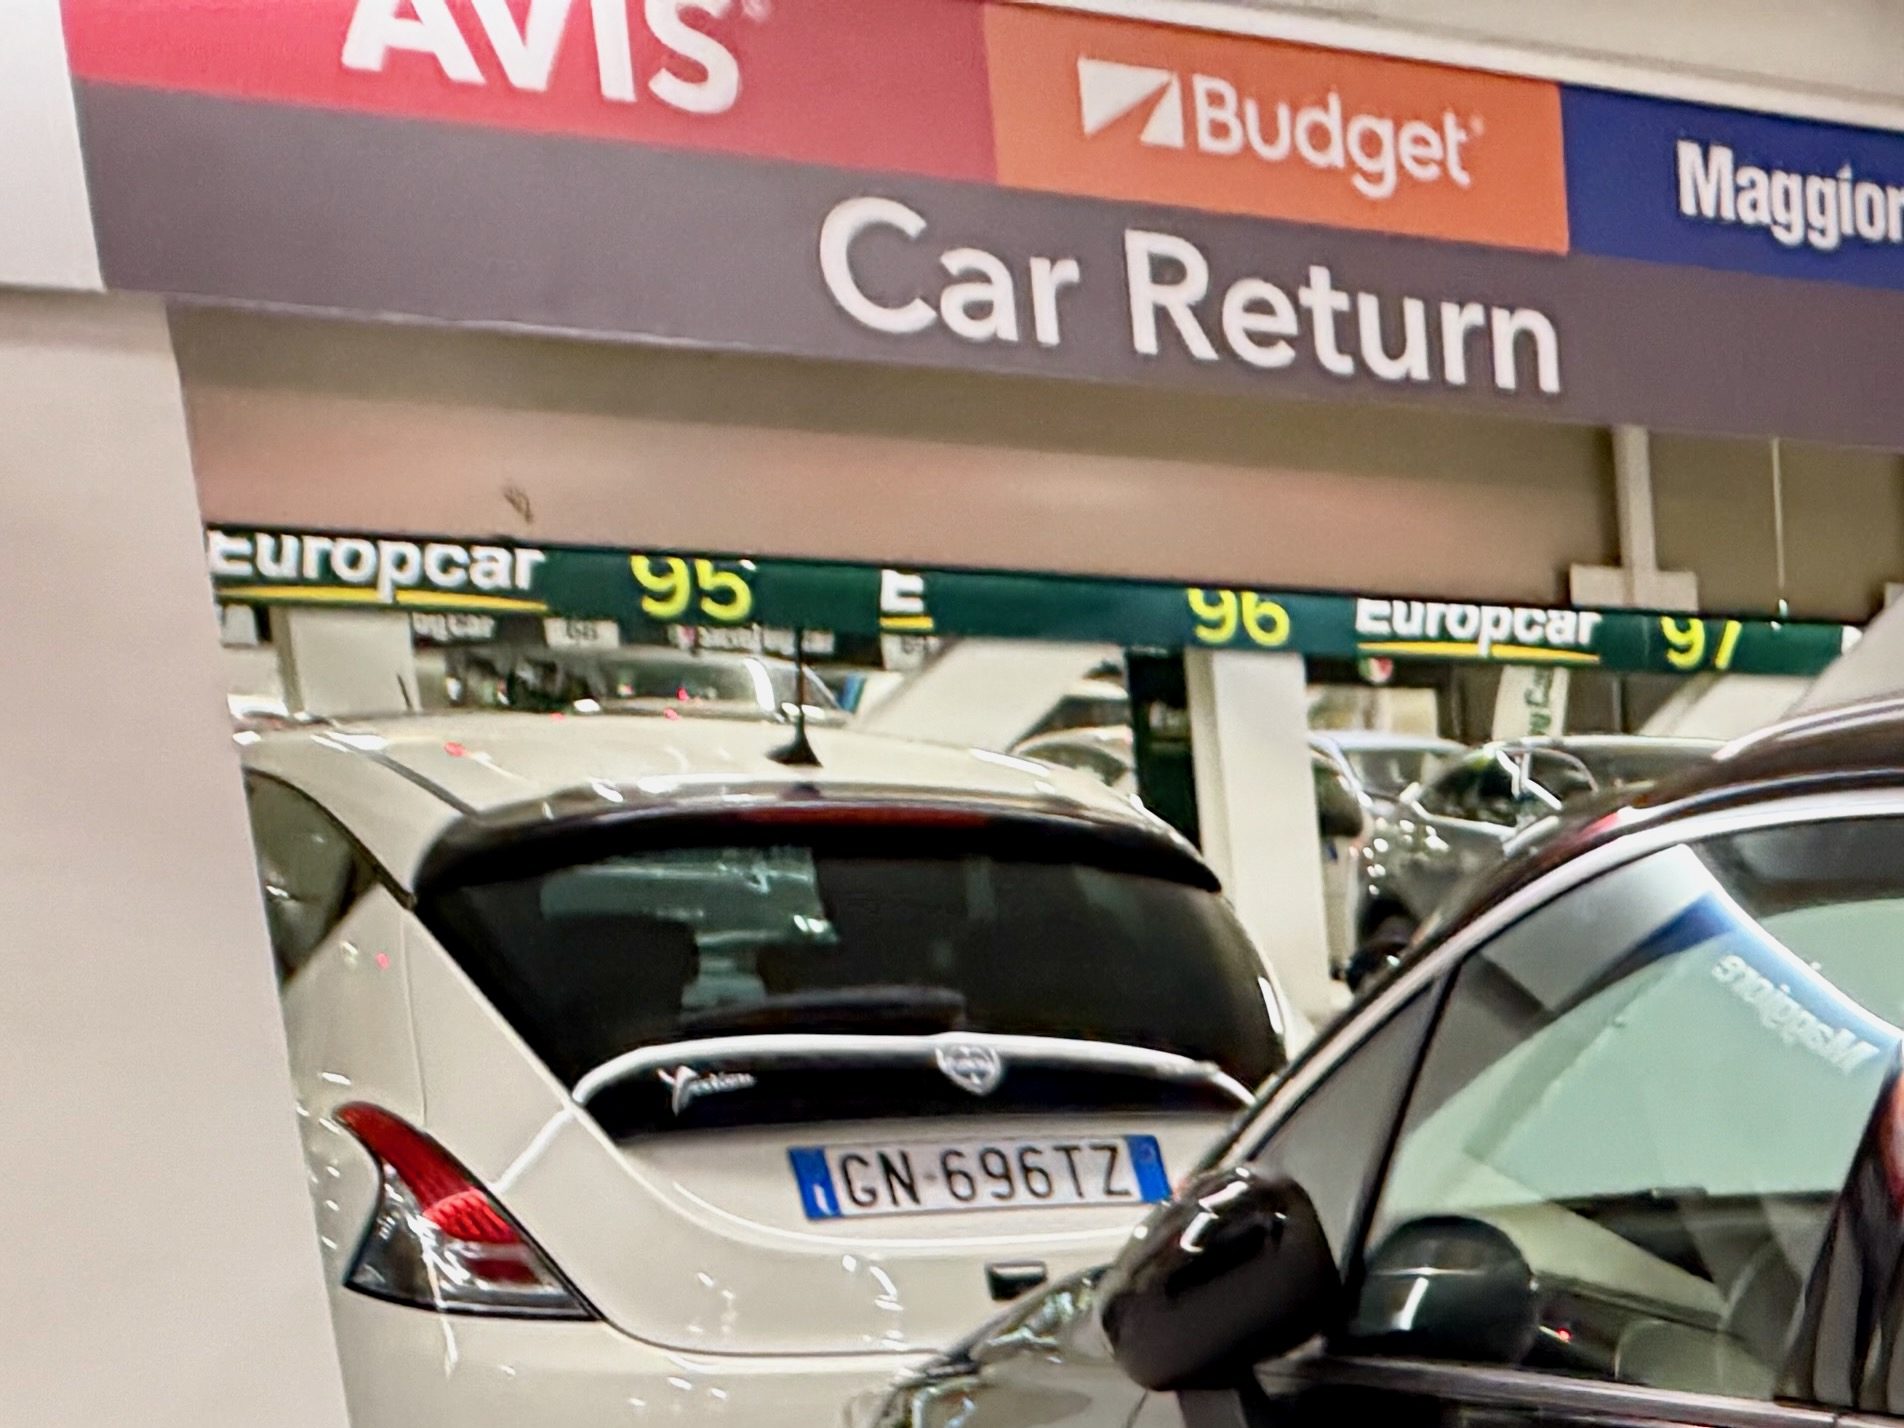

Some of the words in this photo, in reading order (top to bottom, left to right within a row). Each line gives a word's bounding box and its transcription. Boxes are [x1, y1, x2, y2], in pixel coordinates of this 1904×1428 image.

[341, 0, 741, 114] AVIS
[1192, 74, 1474, 199] Budget
[819, 197, 1079, 347] Car
[1125, 228, 1561, 395] Return
[207, 531, 546, 602] Europcar
[630, 555, 752, 622] 95
[1188, 588, 1291, 648] 96
[1356, 598, 1602, 656] Europcar
